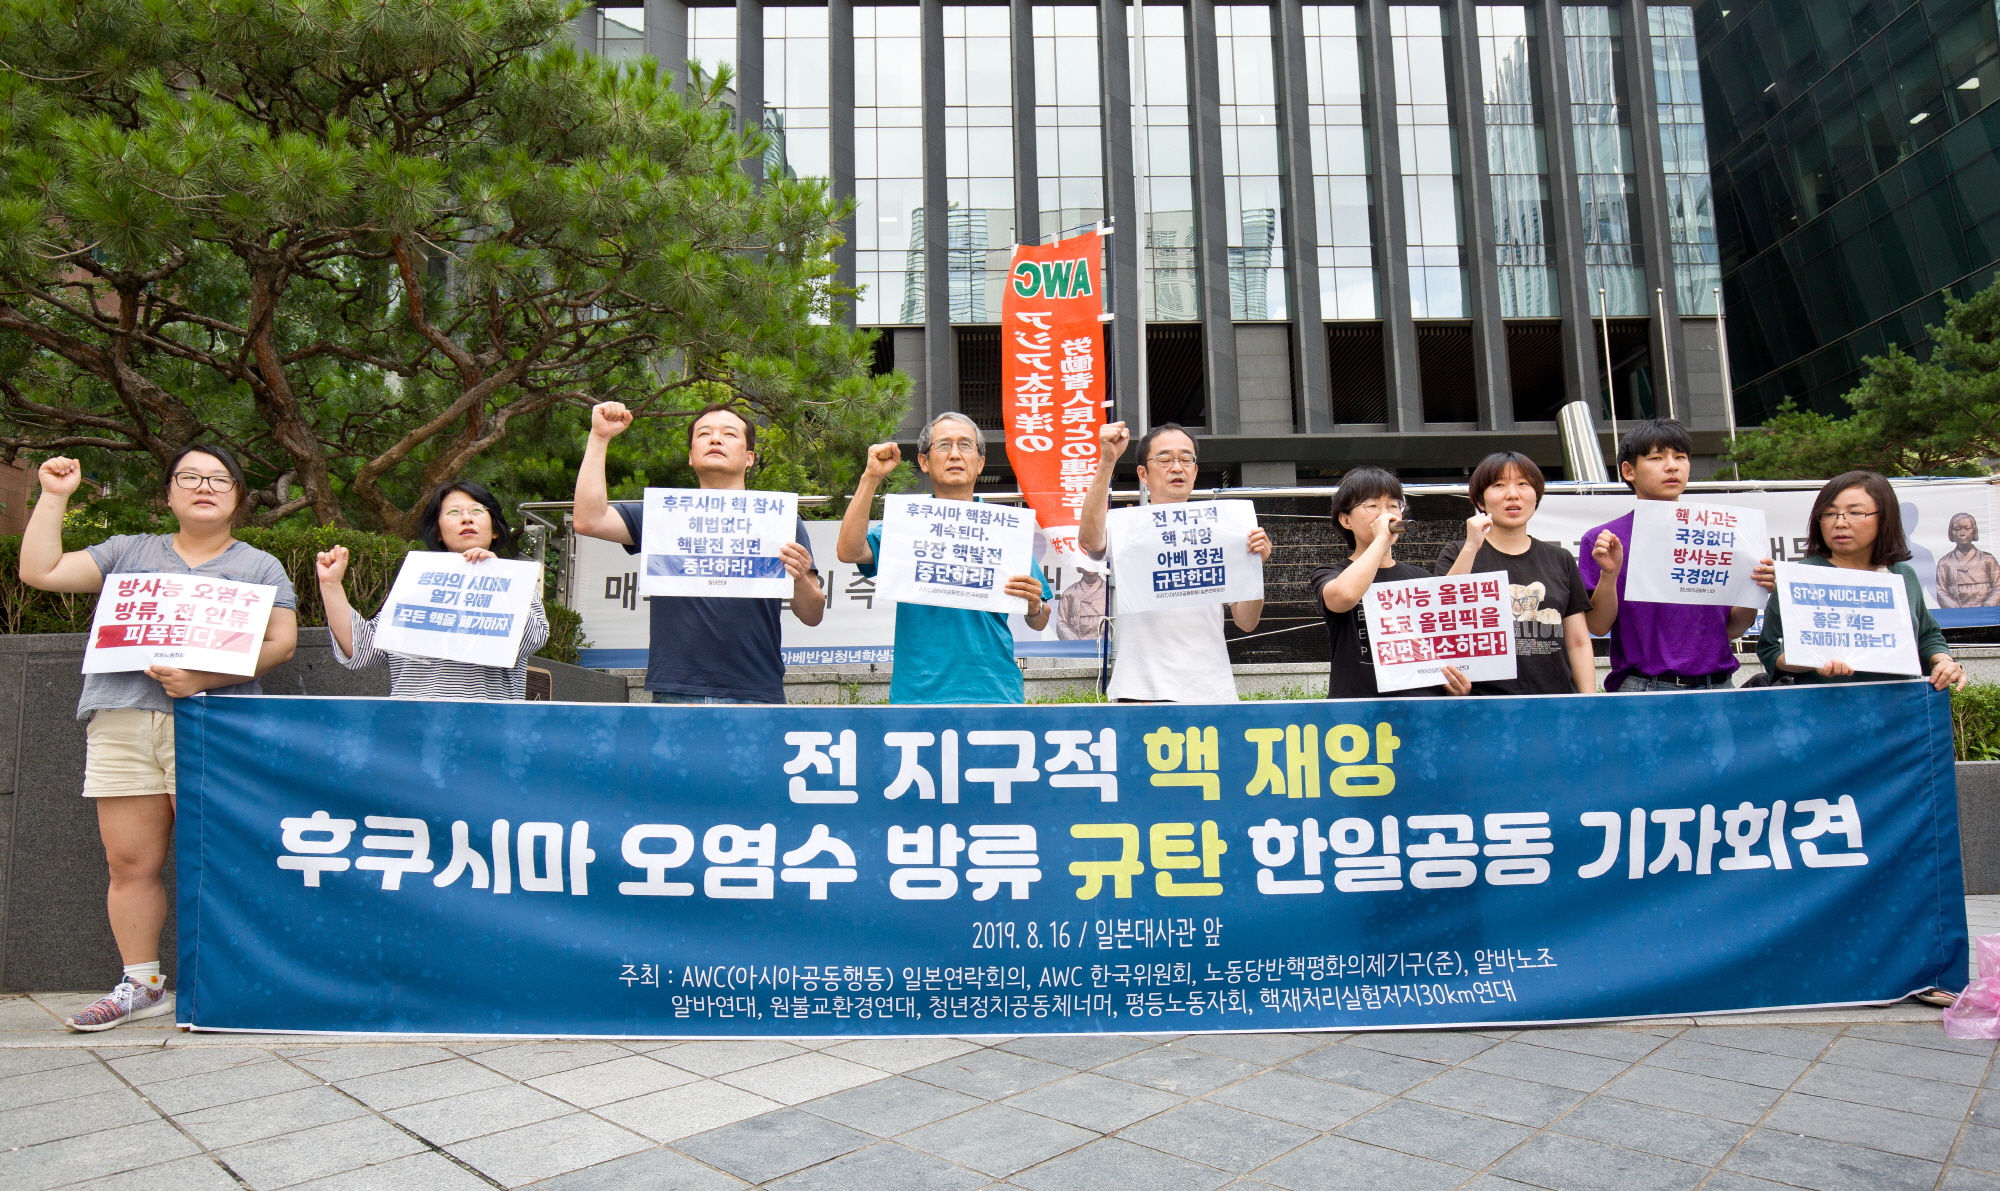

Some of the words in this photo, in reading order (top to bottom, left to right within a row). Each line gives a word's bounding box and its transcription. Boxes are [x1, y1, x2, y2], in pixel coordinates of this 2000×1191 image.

[663, 495, 727, 513] 후쿠시마
[732, 497, 747, 513] 핵
[752, 498, 785, 515] 참사
[906, 503, 962, 521] 후쿠시마
[965, 508, 1020, 528] 핵참사는
[688, 516, 752, 534] 해법없다
[1152, 511, 1167, 528] 전
[1173, 507, 1218, 525] 지구적
[1676, 508, 1690, 525] 핵
[1695, 510, 1738, 528] 사고는
[930, 523, 989, 542] 계속된다.
[1161, 530, 1177, 547] 핵
[1182, 527, 1213, 545] 재앙
[1676, 528, 1736, 548] 국경없다
[677, 537, 724, 554] 핵발전
[730, 538, 761, 555] 전면
[912, 540, 947, 559] 당장
[952, 543, 1003, 566] 핵발전
[683, 558, 753, 576] 중단하라!
[1157, 550, 1188, 568] 아베
[1193, 547, 1224, 566] 정권
[1673, 548, 1734, 566] 방사능도
[417, 571, 466, 589] 평화의
[918, 562, 994, 587] 중단하라!
[1155, 567, 1224, 590] 규탄한다!
[1671, 567, 1730, 586] 국경없다
[118, 578, 184, 598] 방사능
[190, 583, 261, 607] 오염수
[430, 588, 461, 605] 열기
[463, 592, 493, 608] 위해
[1377, 586, 1431, 611] 방사능
[1438, 579, 1500, 606] 올림픽
[1829, 589, 1888, 603] NUCLEAR!
[115, 601, 165, 623] 방류,
[174, 603, 197, 621] 전
[204, 606, 250, 628] 인류
[398, 608, 426, 624] 모든
[428, 611, 457, 627] 핵을
[457, 614, 509, 631] 폐기하자
[1380, 614, 1413, 635] 도쿄
[1419, 606, 1501, 634] 올림픽을
[1813, 612, 1841, 629] 좋은
[123, 625, 223, 648] 피폭된다.
[1800, 630, 1850, 647] 존재하지
[1854, 633, 1897, 648] 않는다
[782, 649, 894, 664] 아베반일청년학생
[1379, 640, 1413, 665] 전면
[1420, 633, 1507, 661] 취소하라!
[783, 728, 859, 804] 전
[884, 726, 1119, 804] 지구적
[1143, 725, 1221, 801] 핵
[1244, 722, 1402, 799] 재앙
[276, 810, 596, 895] 후쿠시마
[618, 823, 858, 900] 오염수
[887, 823, 1042, 901] 방류
[1068, 819, 1228, 900] 규탄
[1248, 811, 1554, 896] 한일공동
[1577, 794, 1870, 880] 기자회견
[972, 920, 1022, 949] 2019.
[1027, 920, 1045, 949] 8.
[1048, 920, 1072, 949] 16
[1095, 918, 1196, 950] 일본대사관
[1203, 916, 1224, 948] 앞
[618, 963, 659, 989] 주최
[681, 963, 894, 992] AWC(아시아공동행동)
[902, 965, 1031, 991] 일본연락회의,
[1039, 966, 1083, 988] AWC
[1090, 961, 1198, 988] 한국위원회,
[1474, 946, 1558, 974] 알바노조
[671, 995, 763, 1020] 알바연대,
[770, 993, 922, 1020] 원불교환경연대,
[929, 993, 1119, 1019] 청년정치공동체너머,
[1125, 989, 1254, 1015] 평등노동자회,
[1260, 979, 1517, 1013] 핵재처리실험저지30km연대
